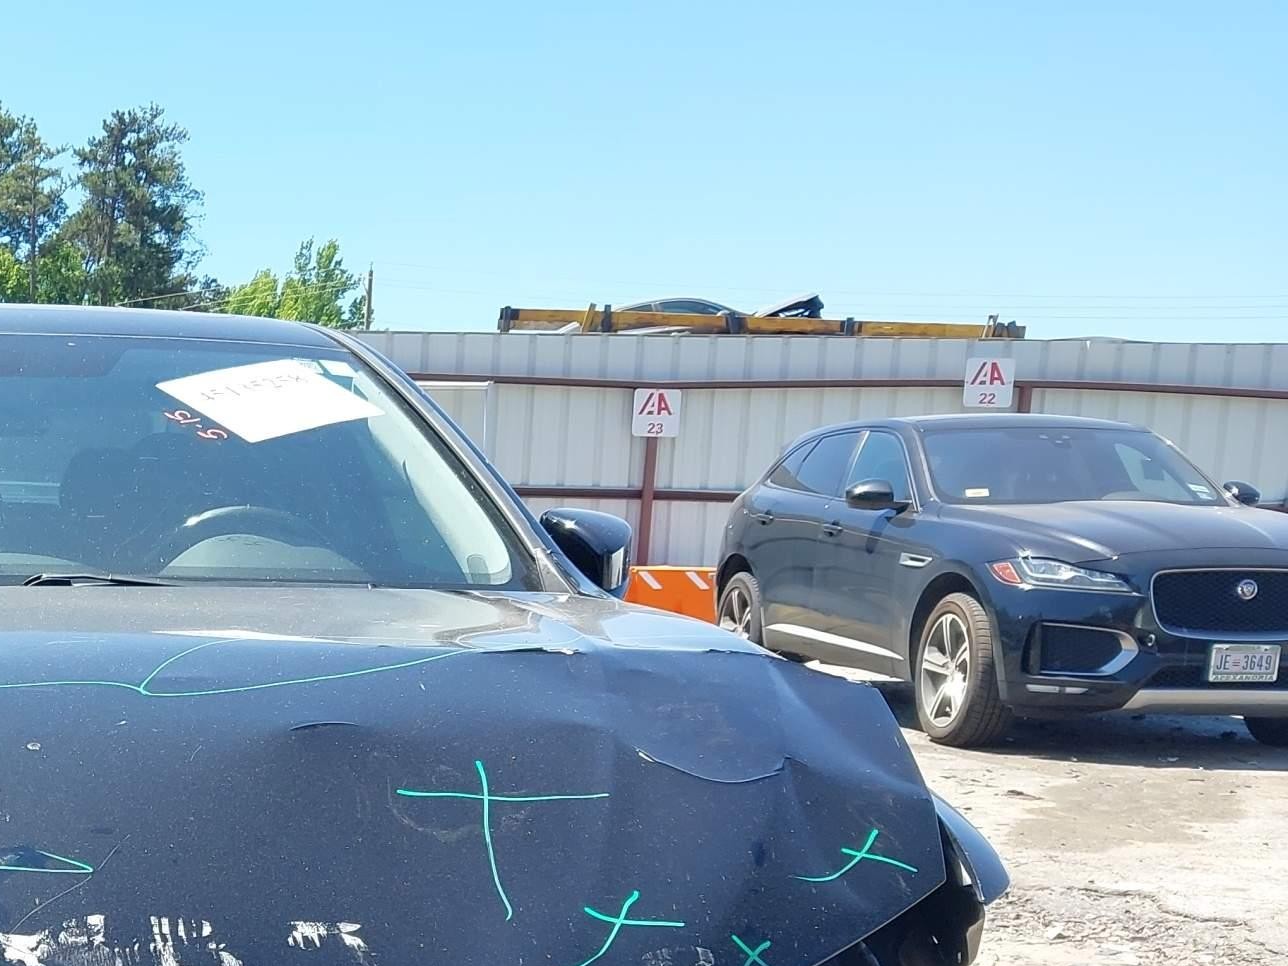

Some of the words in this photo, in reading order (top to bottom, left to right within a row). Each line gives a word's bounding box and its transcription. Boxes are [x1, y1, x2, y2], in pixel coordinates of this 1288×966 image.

[978, 393, 997, 405] 22
[647, 423, 664, 435] 23
[1242, 654, 1273, 671] 3649
